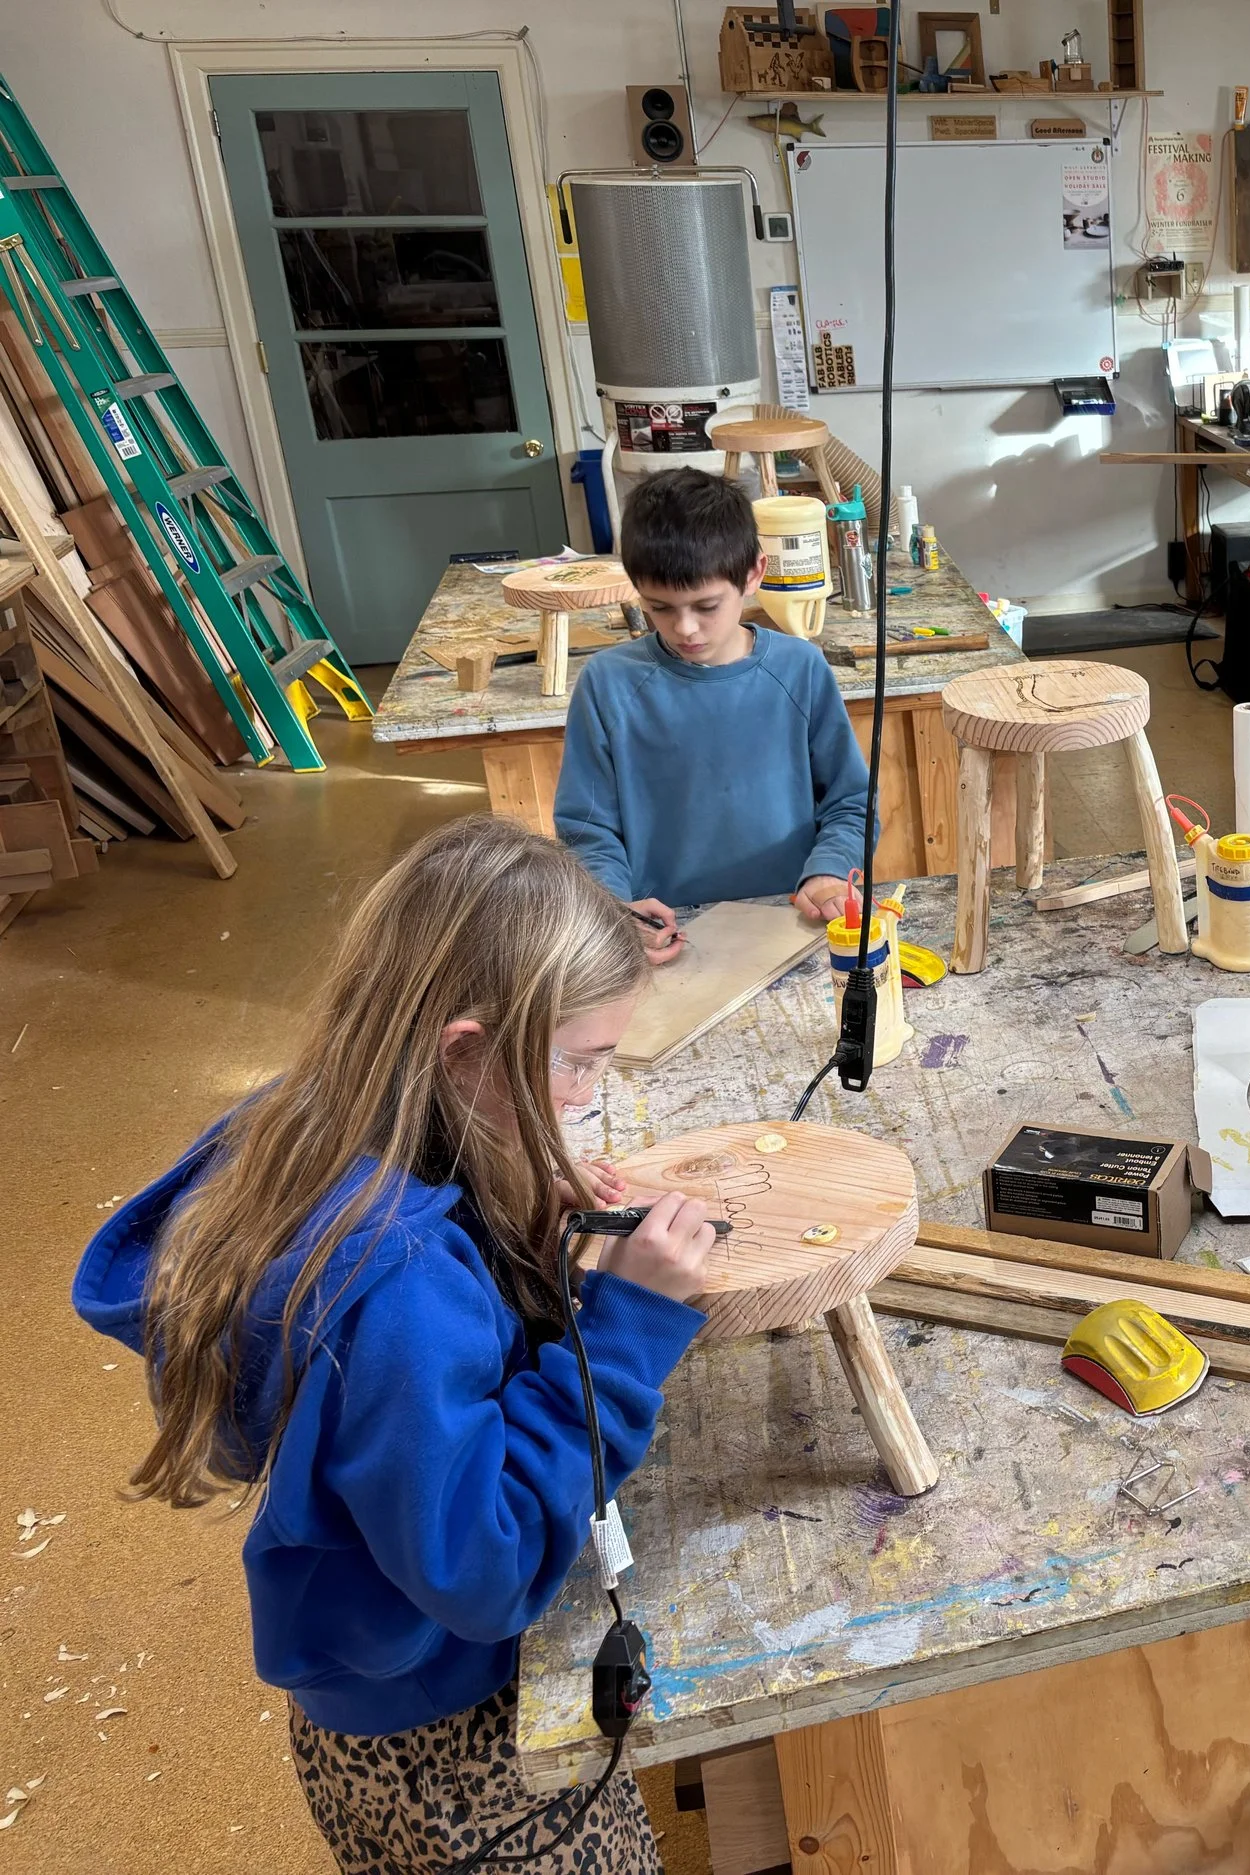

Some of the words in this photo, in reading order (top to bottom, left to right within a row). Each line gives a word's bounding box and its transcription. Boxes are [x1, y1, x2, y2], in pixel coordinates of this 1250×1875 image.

[1148, 144, 1189, 154] FESTIVAL
[1173, 153, 1212, 163] MAKING
[1176, 188, 1185, 201] 6
[1151, 220, 1174, 228] WINTER
[815, 346, 823, 367] LAB
[823, 332, 836, 387] ROBOTICS
[835, 347, 847, 385] TABLES
[163, 516, 193, 561] WERNER
[1100, 1162, 1126, 1170] Cutter
[1125, 1158, 1157, 1167] Embout
[1124, 1171, 1150, 1179] Power
